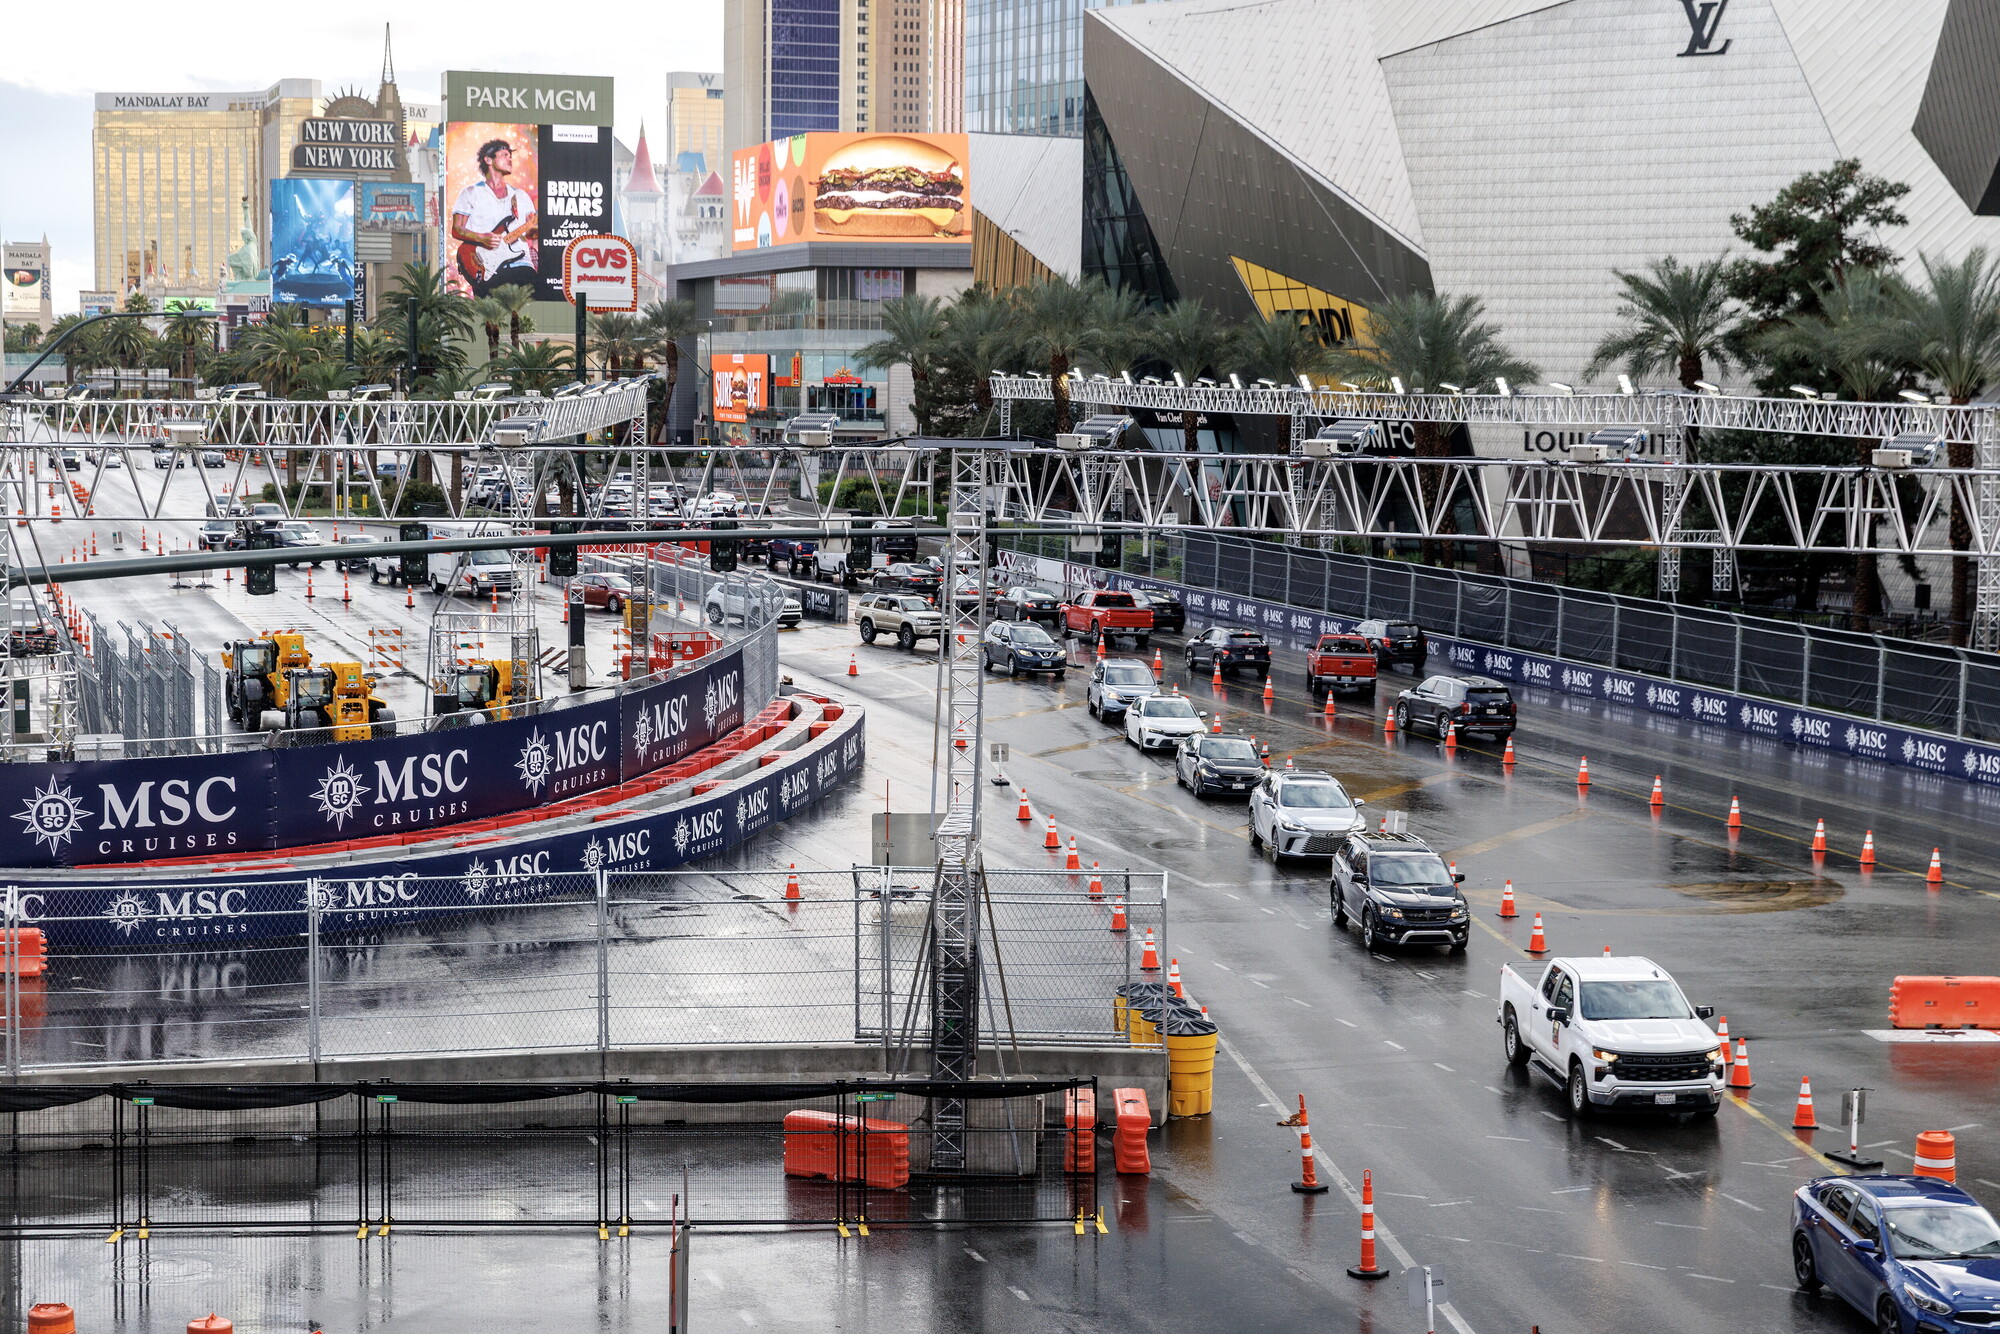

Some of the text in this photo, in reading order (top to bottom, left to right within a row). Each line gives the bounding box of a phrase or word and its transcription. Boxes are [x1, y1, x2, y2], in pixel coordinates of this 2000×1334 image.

[698, 74, 714, 87] W
[115, 96, 210, 108] MANDALAY BAY
[466, 85, 596, 112] PARK MGM
[409, 107, 428, 118] BAY
[304, 121, 395, 143] NEW YORK
[304, 146, 395, 170] NEW YORK
[547, 180, 603, 198] BRUNO
[547, 197, 603, 217] MARS
[552, 229, 568, 238] LAS
[560, 218, 589, 229] Live in
[543, 238, 571, 247] DECEM
[576, 247, 627, 269] CVS
[42, 263, 50, 300] LUXOR
[577, 274, 626, 284] pharmacy
[716, 371, 762, 409] SURE BET
[1155, 412, 1168, 422] Van
[1167, 412, 1182, 423] Cleef
[1524, 431, 1583, 452] LOUI
[815, 592, 830, 606] MGM
[1192, 593, 1205, 606] MSC
[1217, 598, 1230, 612] MSC
[1243, 604, 1257, 618] MSC
[1270, 609, 1284, 624] MSC
[1298, 615, 1312, 630] MSC
[1327, 621, 1342, 635] MSC
[1457, 646, 1475, 664] MSC
[1494, 654, 1512, 671] MSC
[1532, 662, 1552, 679] MSC
[1572, 670, 1592, 688] MSC
[717, 670, 738, 715] MSC
[1614, 678, 1636, 696] MSC
[1658, 687, 1680, 706] MSC
[1704, 697, 1728, 716] MSC
[1752, 706, 1778, 727] MSC
[654, 694, 688, 743] MSC
[717, 712, 738, 733] CRUISES
[1804, 718, 1830, 738] MSC
[555, 721, 607, 772] MSC
[1859, 728, 1887, 750] MSC
[653, 740, 688, 762] CRUISES
[1916, 740, 1947, 763] MSC
[823, 749, 838, 778] MSC
[374, 750, 468, 804] MSC
[554, 768, 606, 794] CRUISES
[792, 767, 810, 798] MSC
[98, 776, 236, 830] MSC
[748, 786, 769, 819] MSC
[792, 794, 810, 810] CRUISES
[374, 800, 468, 828] CRUISES
[748, 814, 769, 830] CRUISES
[691, 808, 723, 841] MSC
[98, 831, 237, 854] CRUISES
[607, 829, 650, 863] MSC
[691, 838, 723, 854] CRUISES
[495, 850, 550, 886] MSC
[345, 872, 419, 908] MSC
[495, 882, 551, 900] CRUISES
[156, 888, 247, 922] MSC
[156, 923, 248, 938] CRUISES
